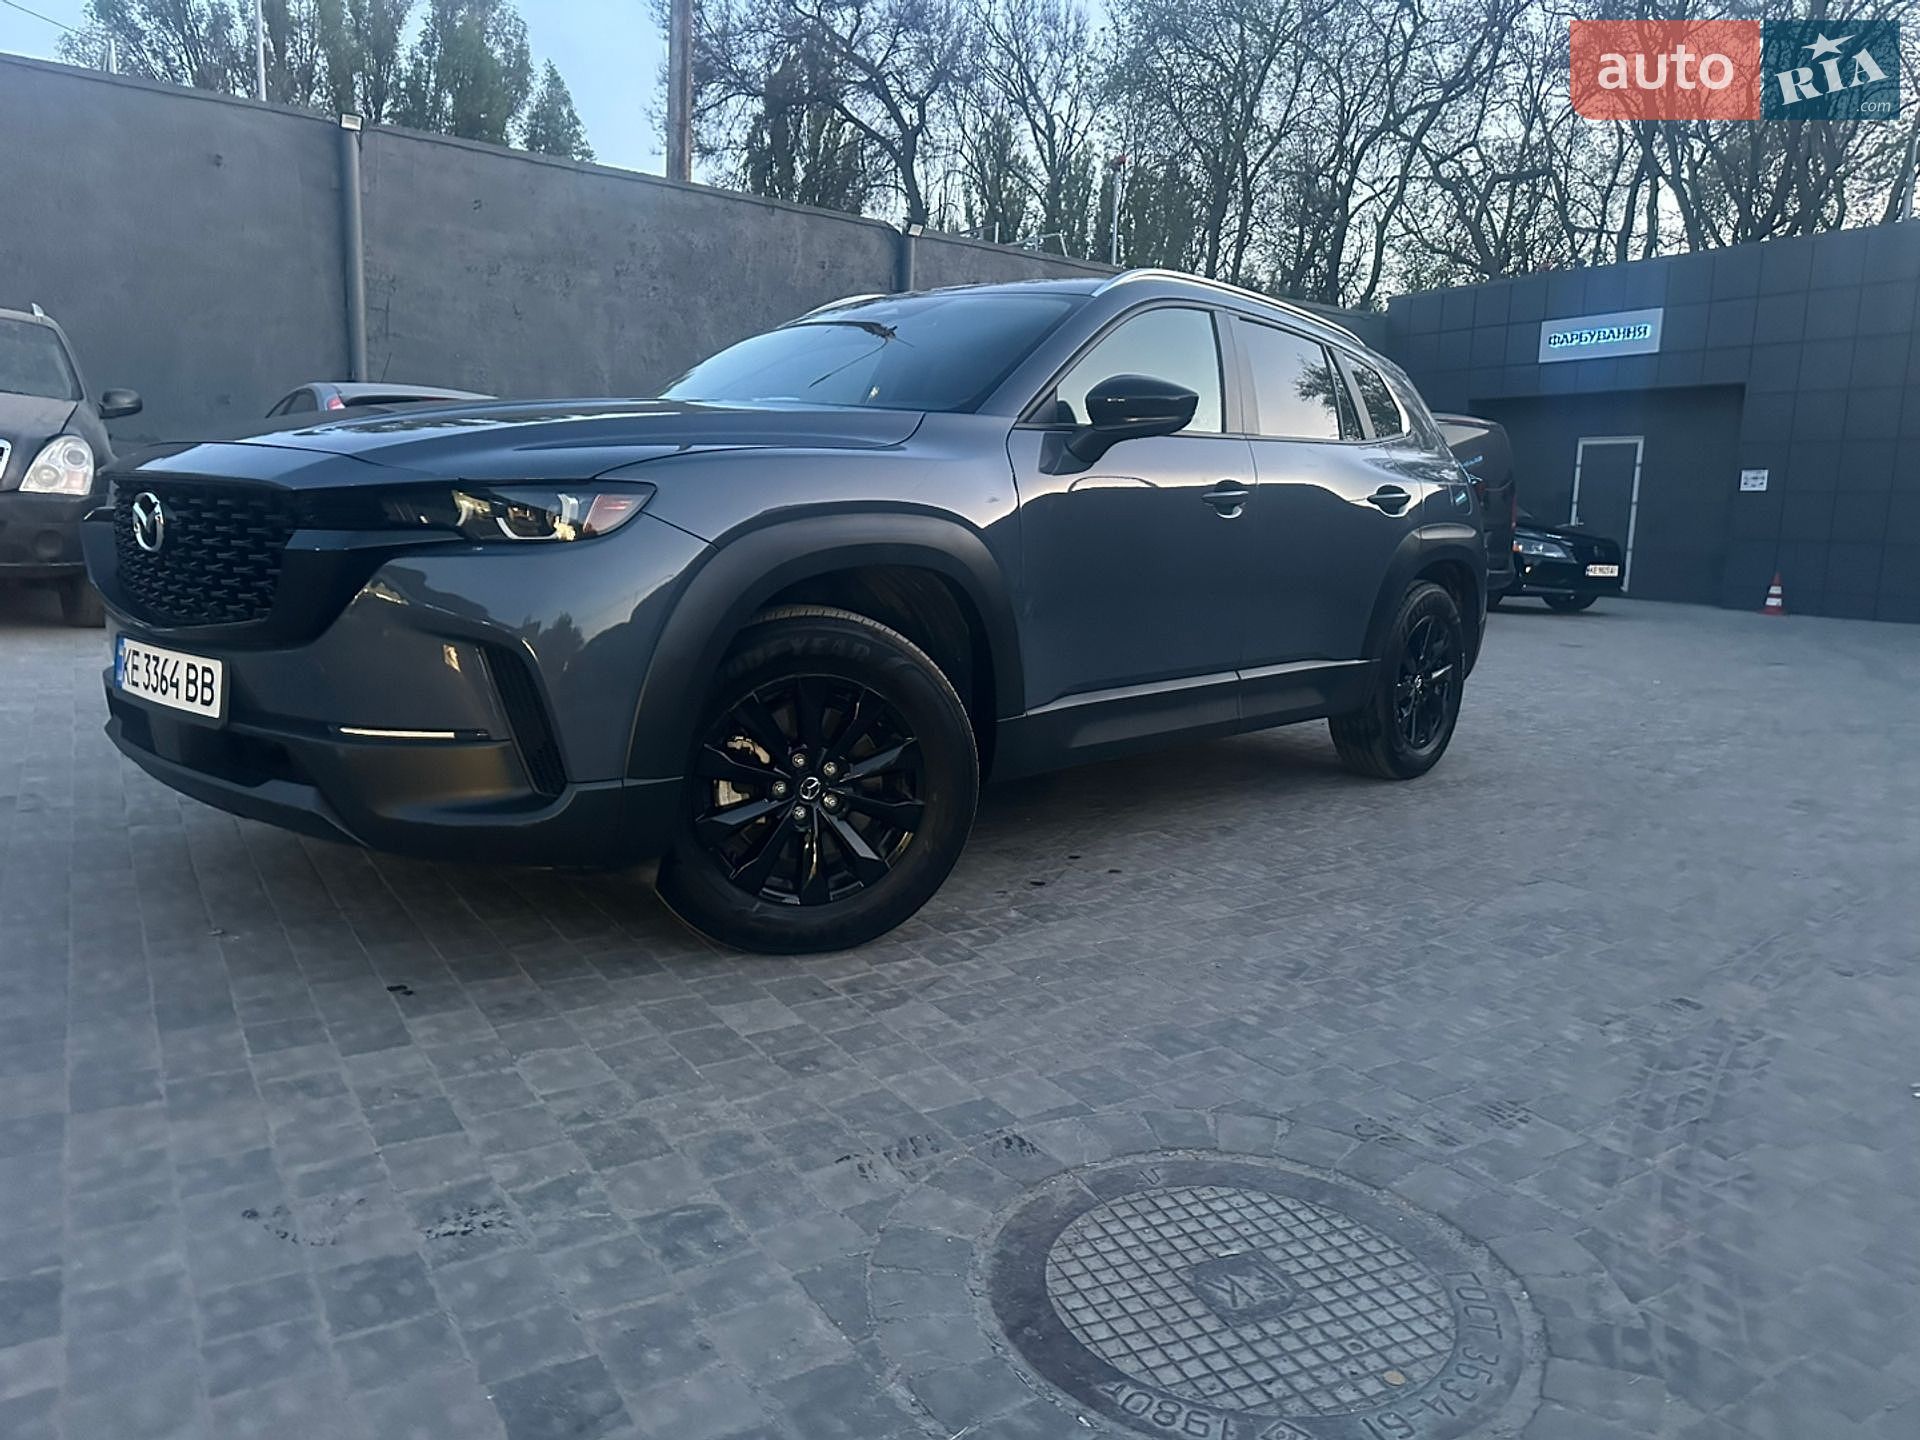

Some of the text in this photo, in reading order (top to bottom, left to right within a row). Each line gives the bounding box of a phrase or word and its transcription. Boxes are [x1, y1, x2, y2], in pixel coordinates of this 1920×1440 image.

[1548, 323, 1651, 348] ФАРБУВАННЯ
[142, 653, 179, 700] 3364
[185, 662, 215, 707] BB
